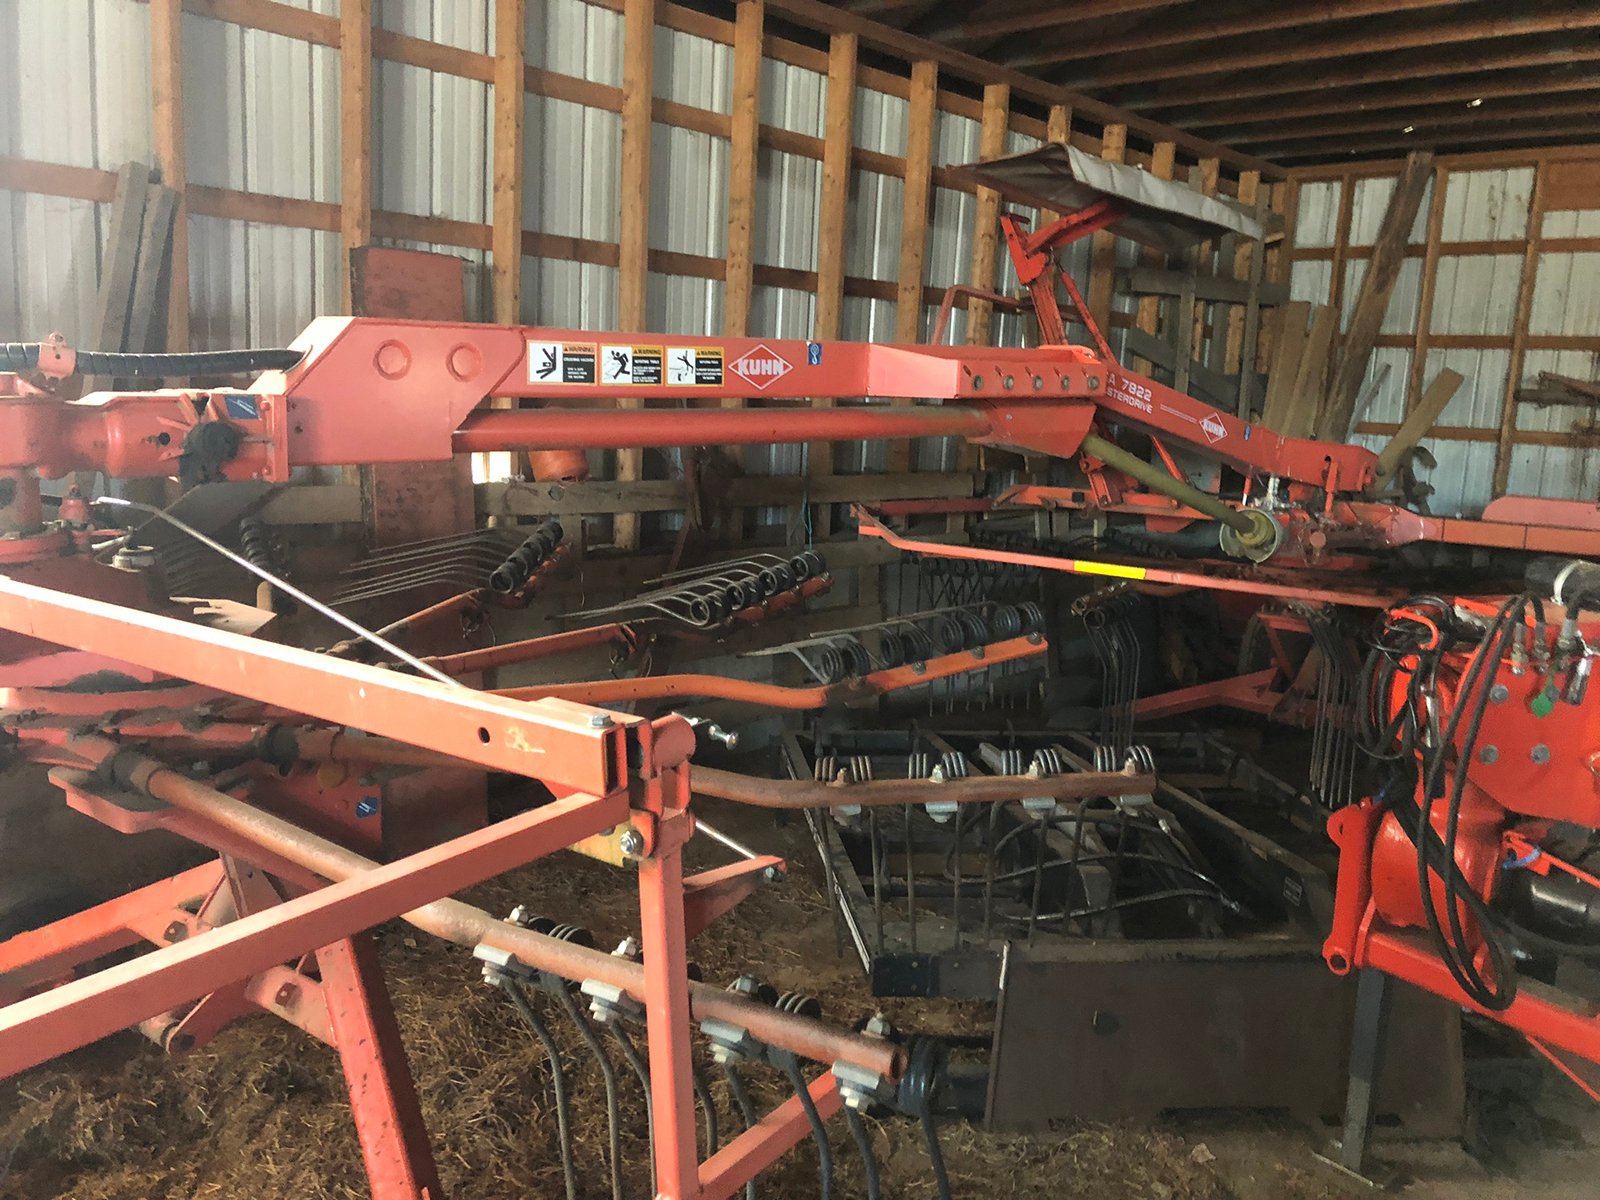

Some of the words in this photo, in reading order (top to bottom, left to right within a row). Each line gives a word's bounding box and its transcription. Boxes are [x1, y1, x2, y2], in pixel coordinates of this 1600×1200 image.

[738, 359, 784, 376] KUHN
[1106, 386, 1153, 414] STERDRIVE
[1120, 377, 1152, 402] 7822
